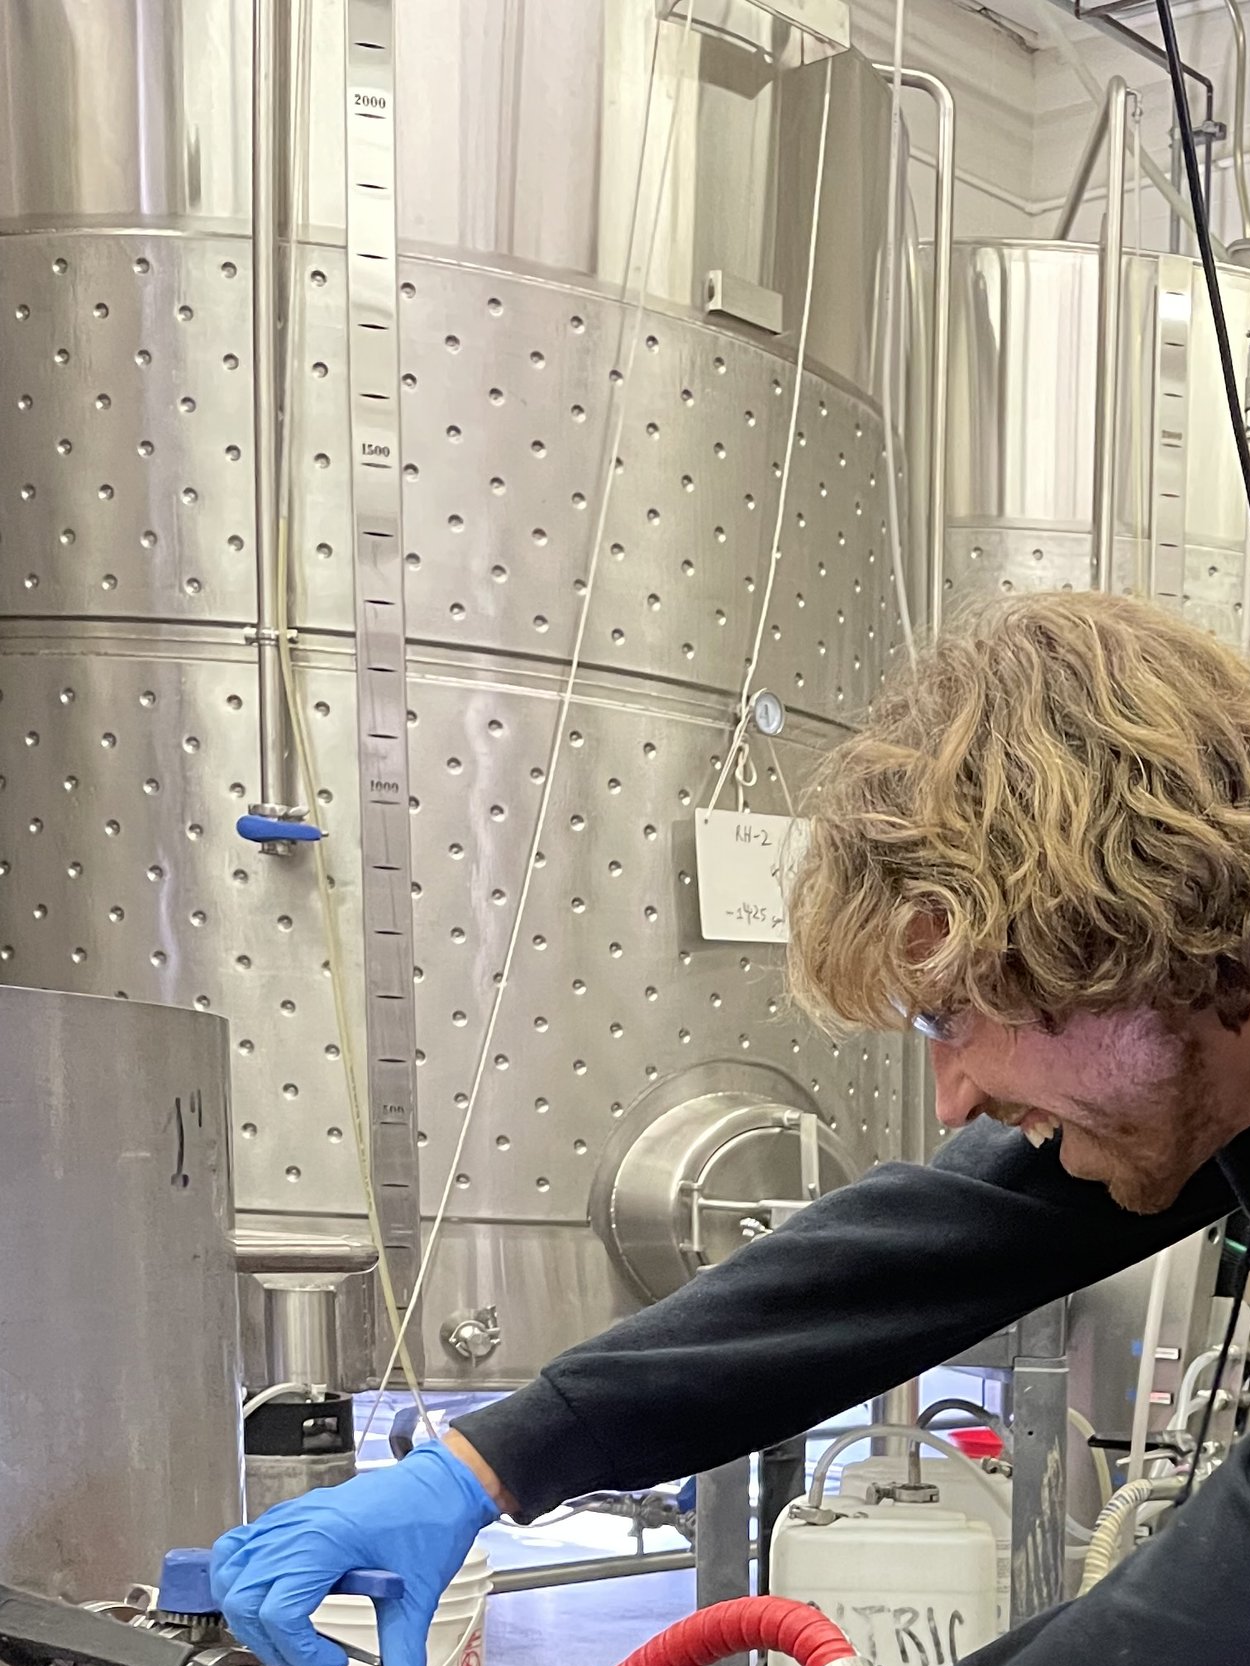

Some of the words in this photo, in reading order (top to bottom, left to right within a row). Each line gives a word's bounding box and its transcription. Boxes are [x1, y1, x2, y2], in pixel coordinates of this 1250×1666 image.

[354, 93, 386, 109] 2000
[362, 443, 391, 457] 1500
[370, 779, 399, 793] 1000
